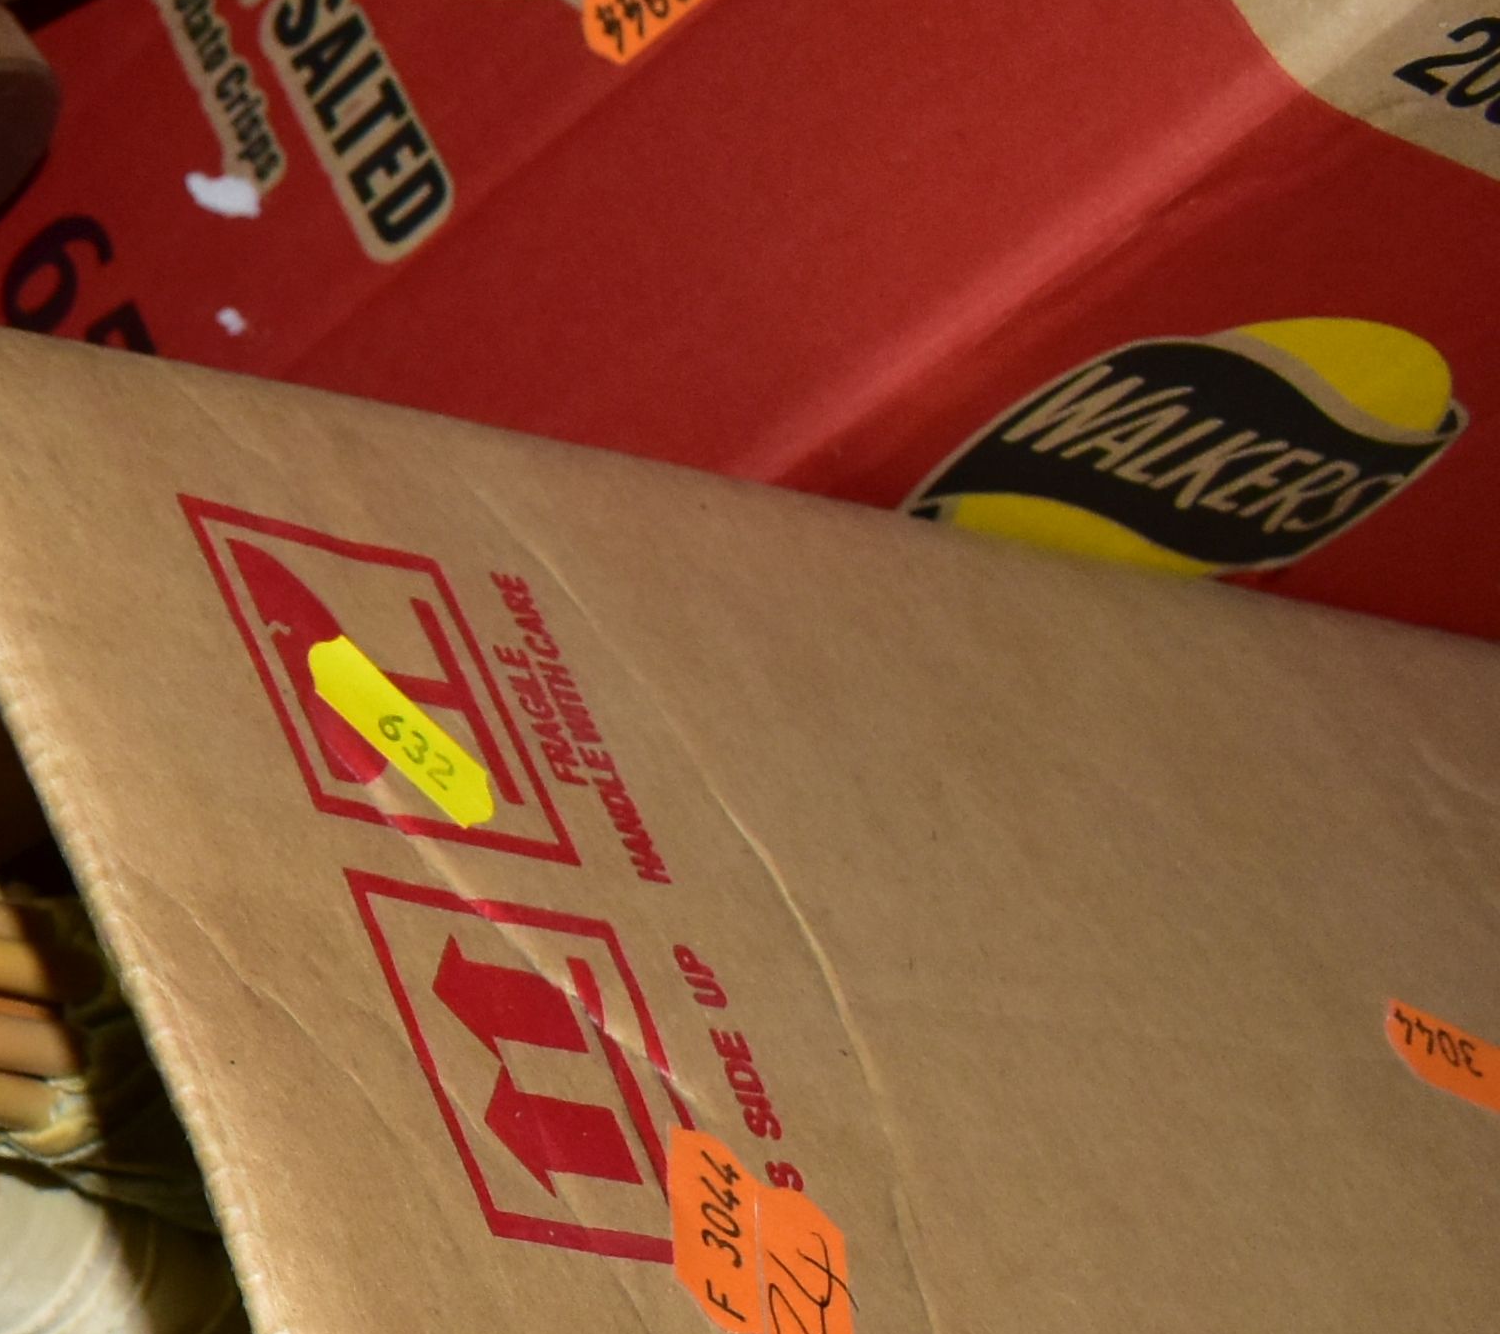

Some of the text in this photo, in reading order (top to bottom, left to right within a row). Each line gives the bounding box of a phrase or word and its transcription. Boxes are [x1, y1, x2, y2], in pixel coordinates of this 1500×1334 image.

[214, 61, 282, 181] Crisps
[1002, 365, 1405, 535] WALKERS
[378, 714, 455, 791] 632
[490, 571, 672, 884] HANDLE WITH CARE
[493, 644, 588, 785] FRAGILE
[673, 944, 728, 1009] UP
[709, 1027, 783, 1142] SIDE
[1394, 1008, 1484, 1078] 3044
[700, 1150, 747, 1323] F 3044
